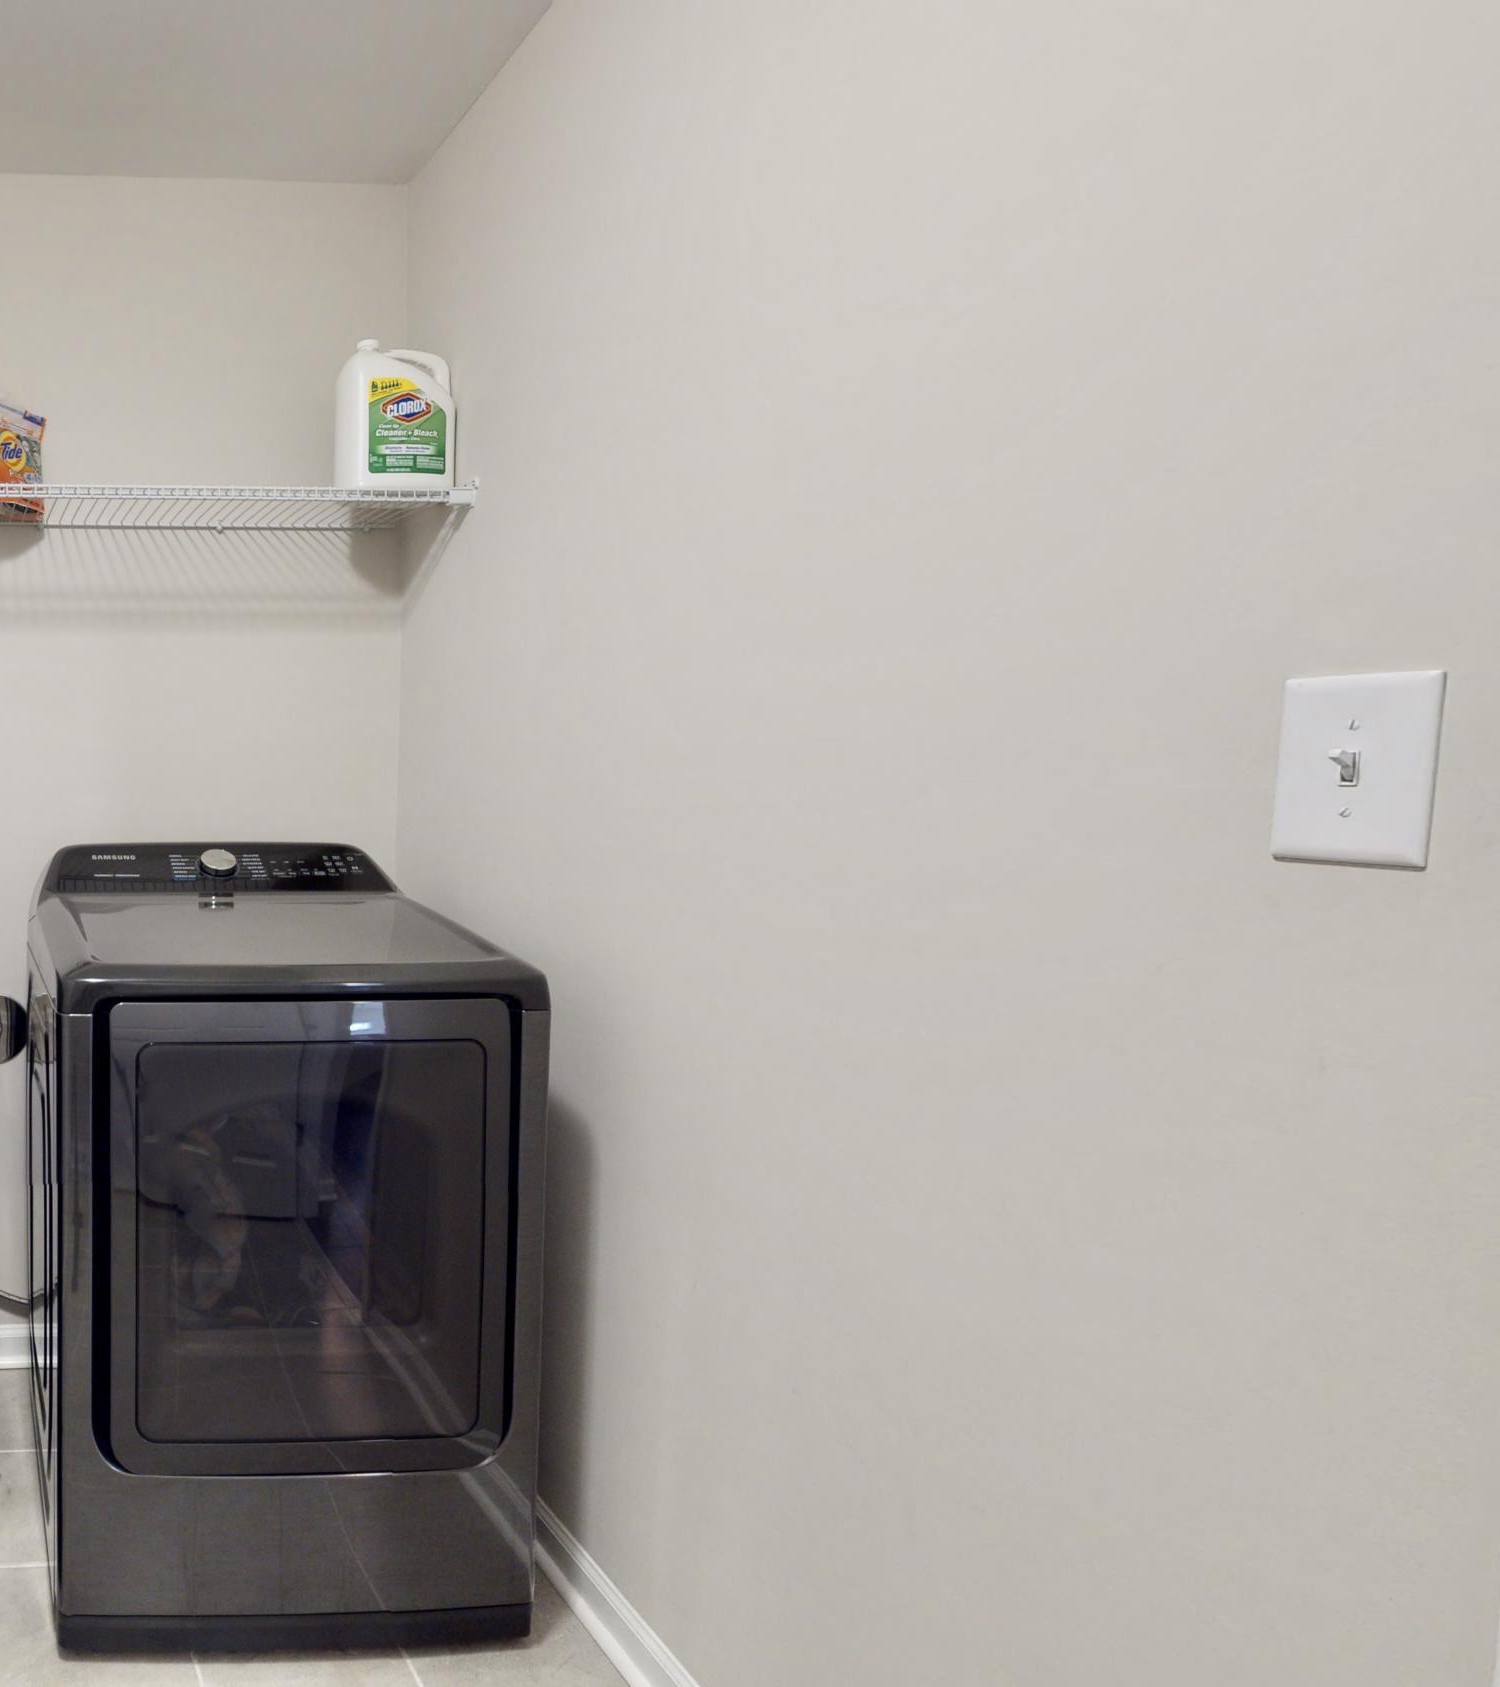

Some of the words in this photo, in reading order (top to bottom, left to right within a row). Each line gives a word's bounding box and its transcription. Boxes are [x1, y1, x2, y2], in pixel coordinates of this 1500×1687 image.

[386, 399, 426, 418] CLOROX
[376, 429, 407, 437] Cleaner
[413, 429, 438, 437] Bleach
[1, 442, 23, 460] Tide
